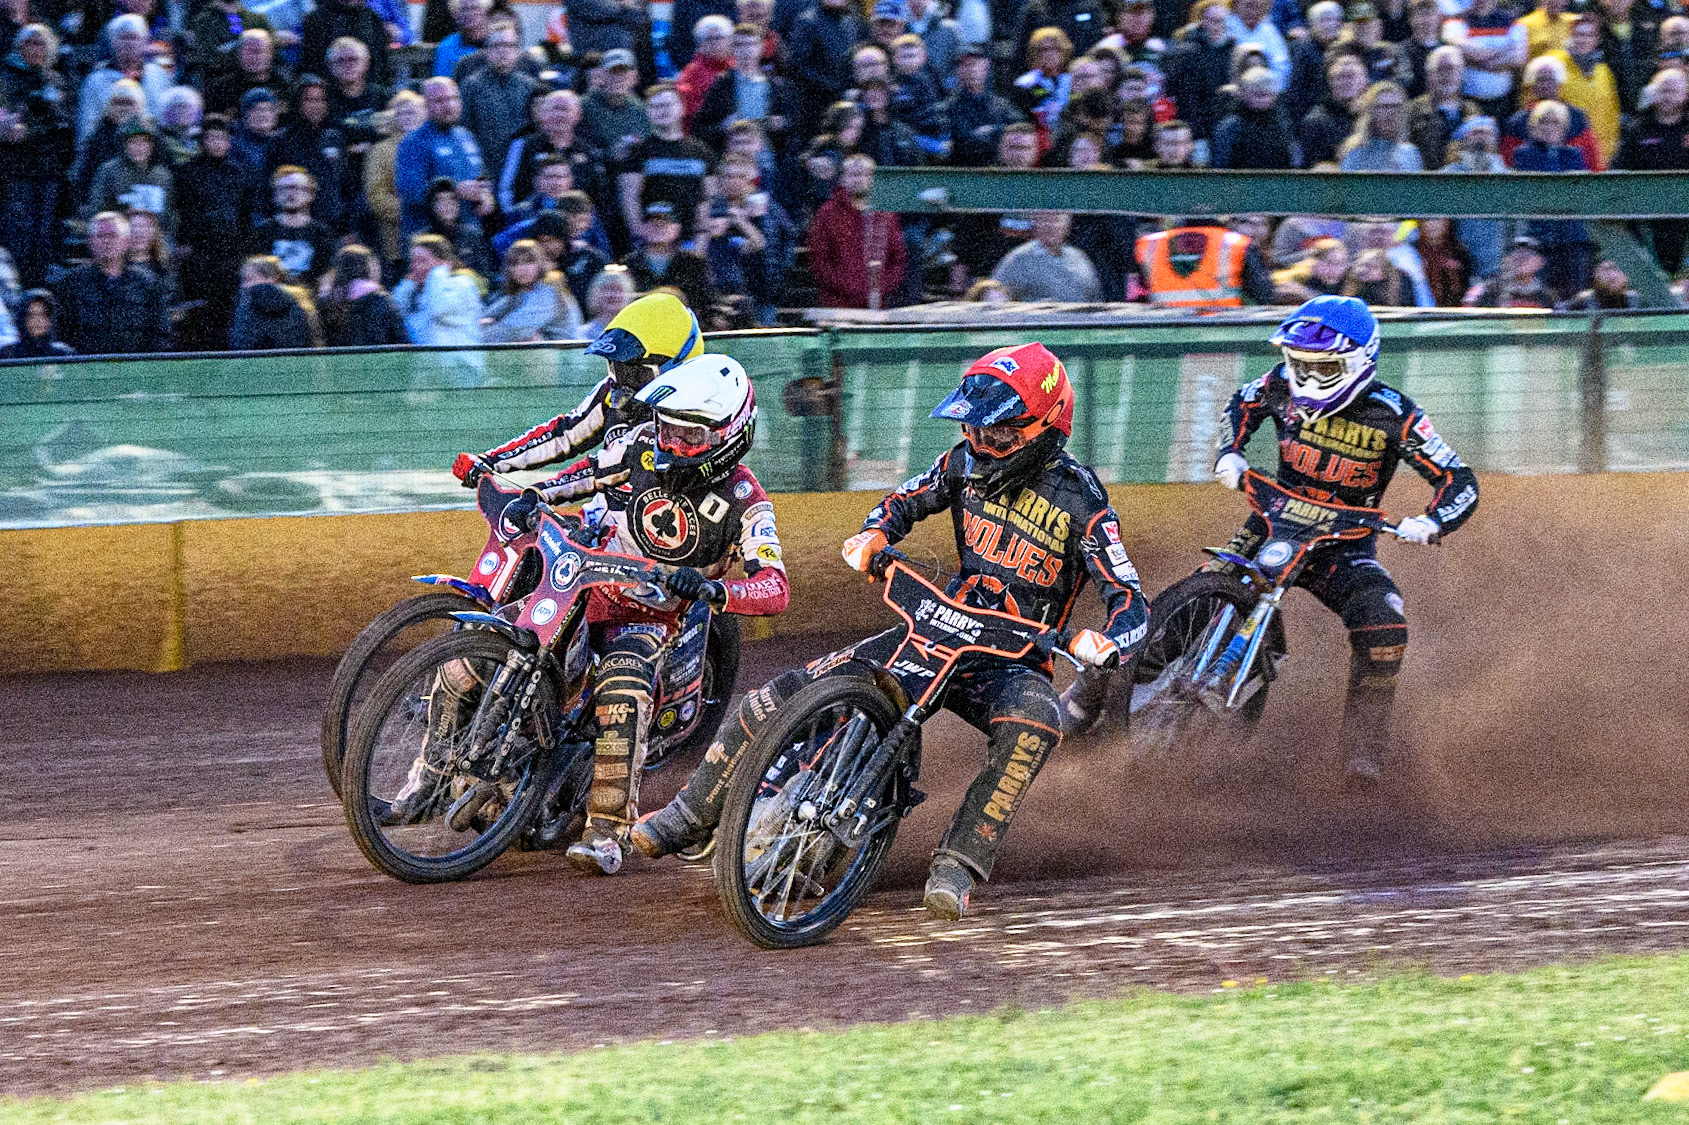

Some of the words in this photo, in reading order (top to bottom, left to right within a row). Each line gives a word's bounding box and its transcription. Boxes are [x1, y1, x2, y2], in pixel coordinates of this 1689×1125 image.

[1278, 438, 1382, 489] WOLVES
[643, 490, 669, 504] BELLE
[686, 511, 697, 537] ACES
[982, 500, 1066, 555] INTERNATIONAL
[998, 486, 1072, 542] ARRYS
[962, 507, 1064, 588] WOLVES
[537, 605, 552, 617] ATPI
[929, 618, 977, 645] INTERNATIONAL
[932, 604, 985, 637] PARRYS
[894, 659, 936, 678] JWP
[983, 731, 1041, 822] PARRYS
